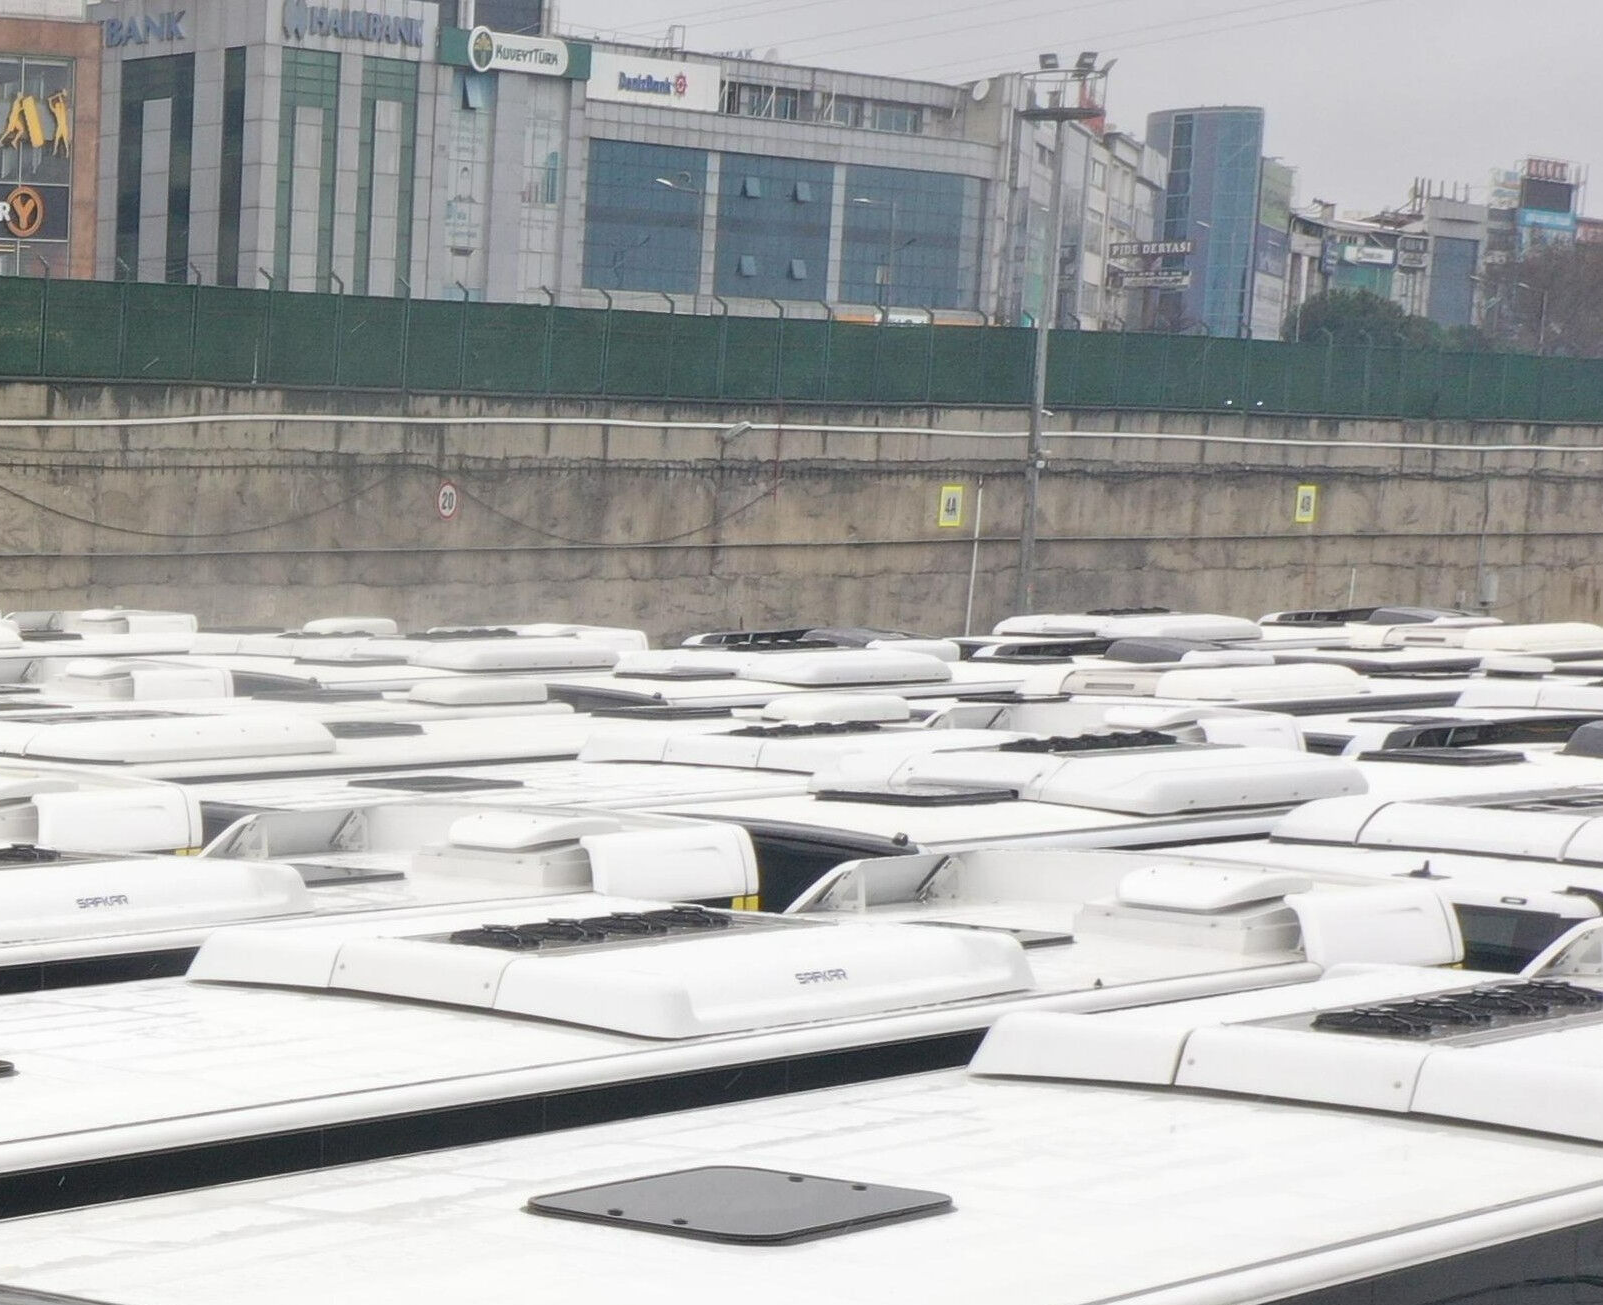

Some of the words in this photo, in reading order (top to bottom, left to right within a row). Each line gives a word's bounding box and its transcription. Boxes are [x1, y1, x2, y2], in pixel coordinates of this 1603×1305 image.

[99, 10, 186, 47] BANK
[442, 491, 455, 511] 20
[795, 968, 849, 985] SAFKAR
